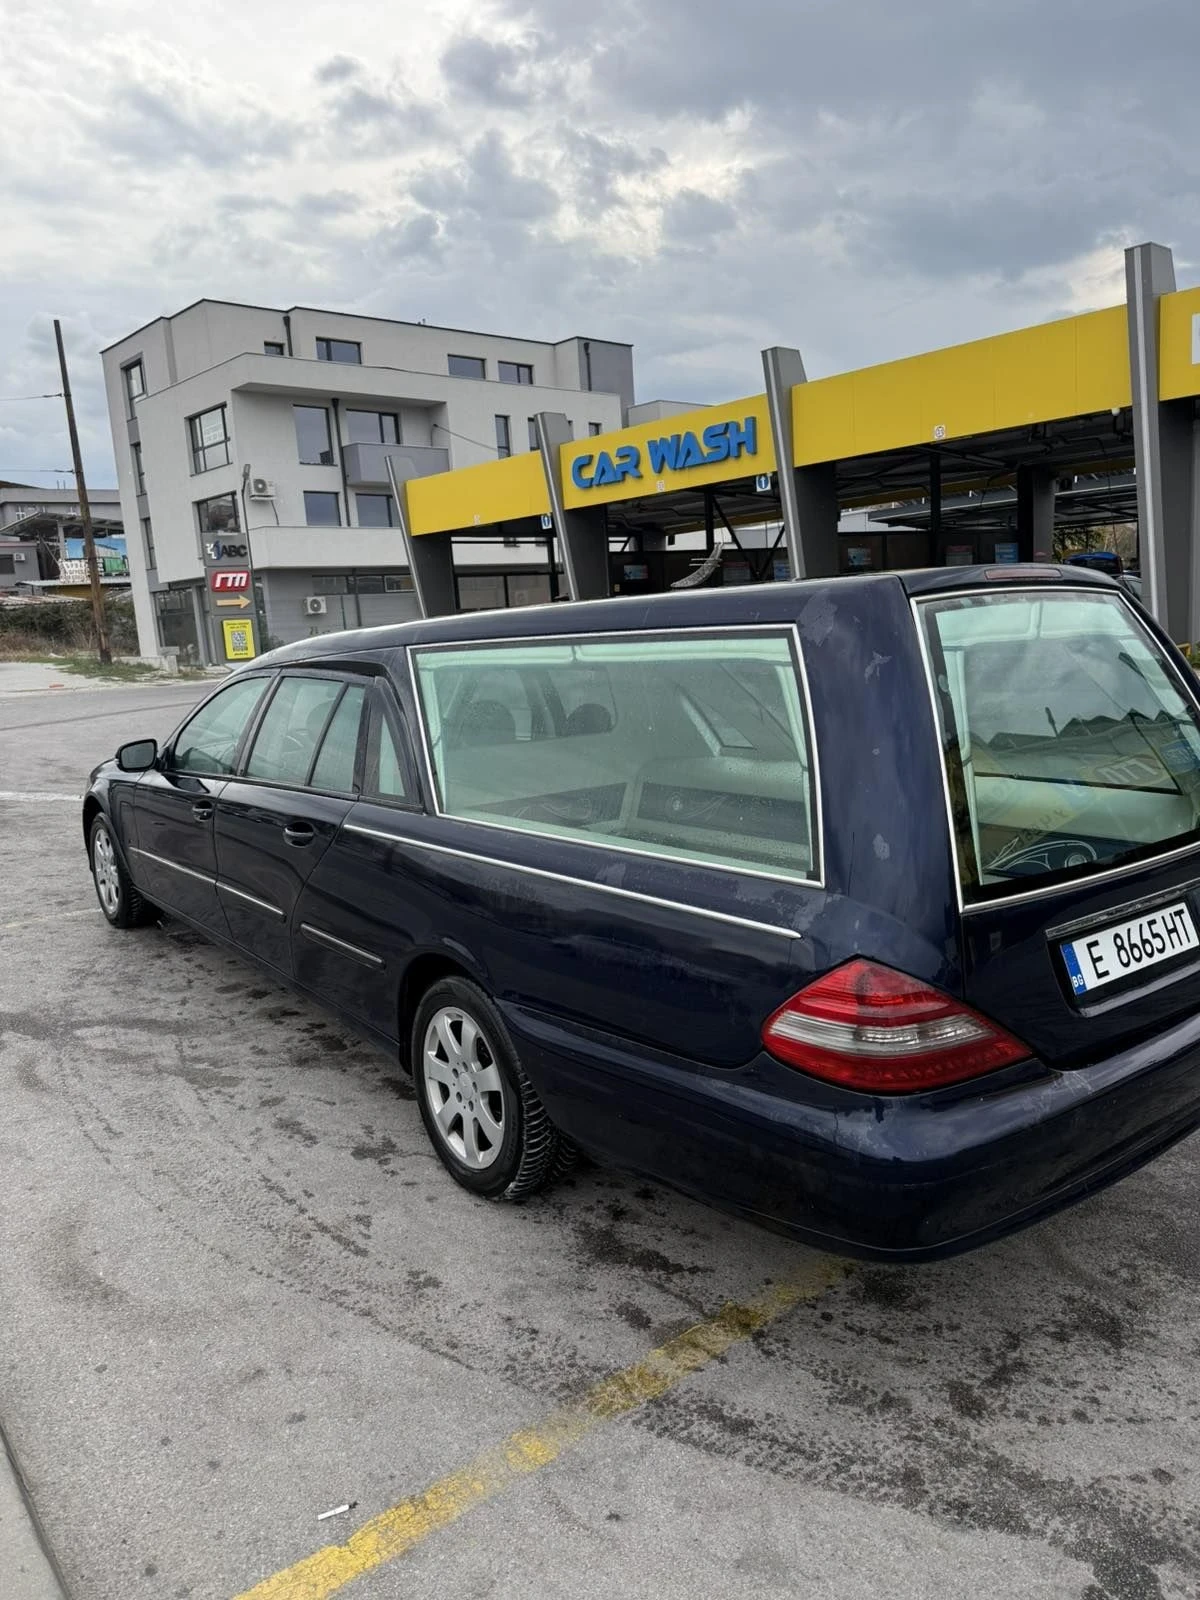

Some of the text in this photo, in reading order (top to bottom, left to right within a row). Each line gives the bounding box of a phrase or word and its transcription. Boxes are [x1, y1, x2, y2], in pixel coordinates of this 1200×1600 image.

[572, 416, 757, 490] CAR WASH
[221, 545, 247, 558] ABC
[1086, 940, 1110, 980] E
[1072, 974, 1084, 988] BG
